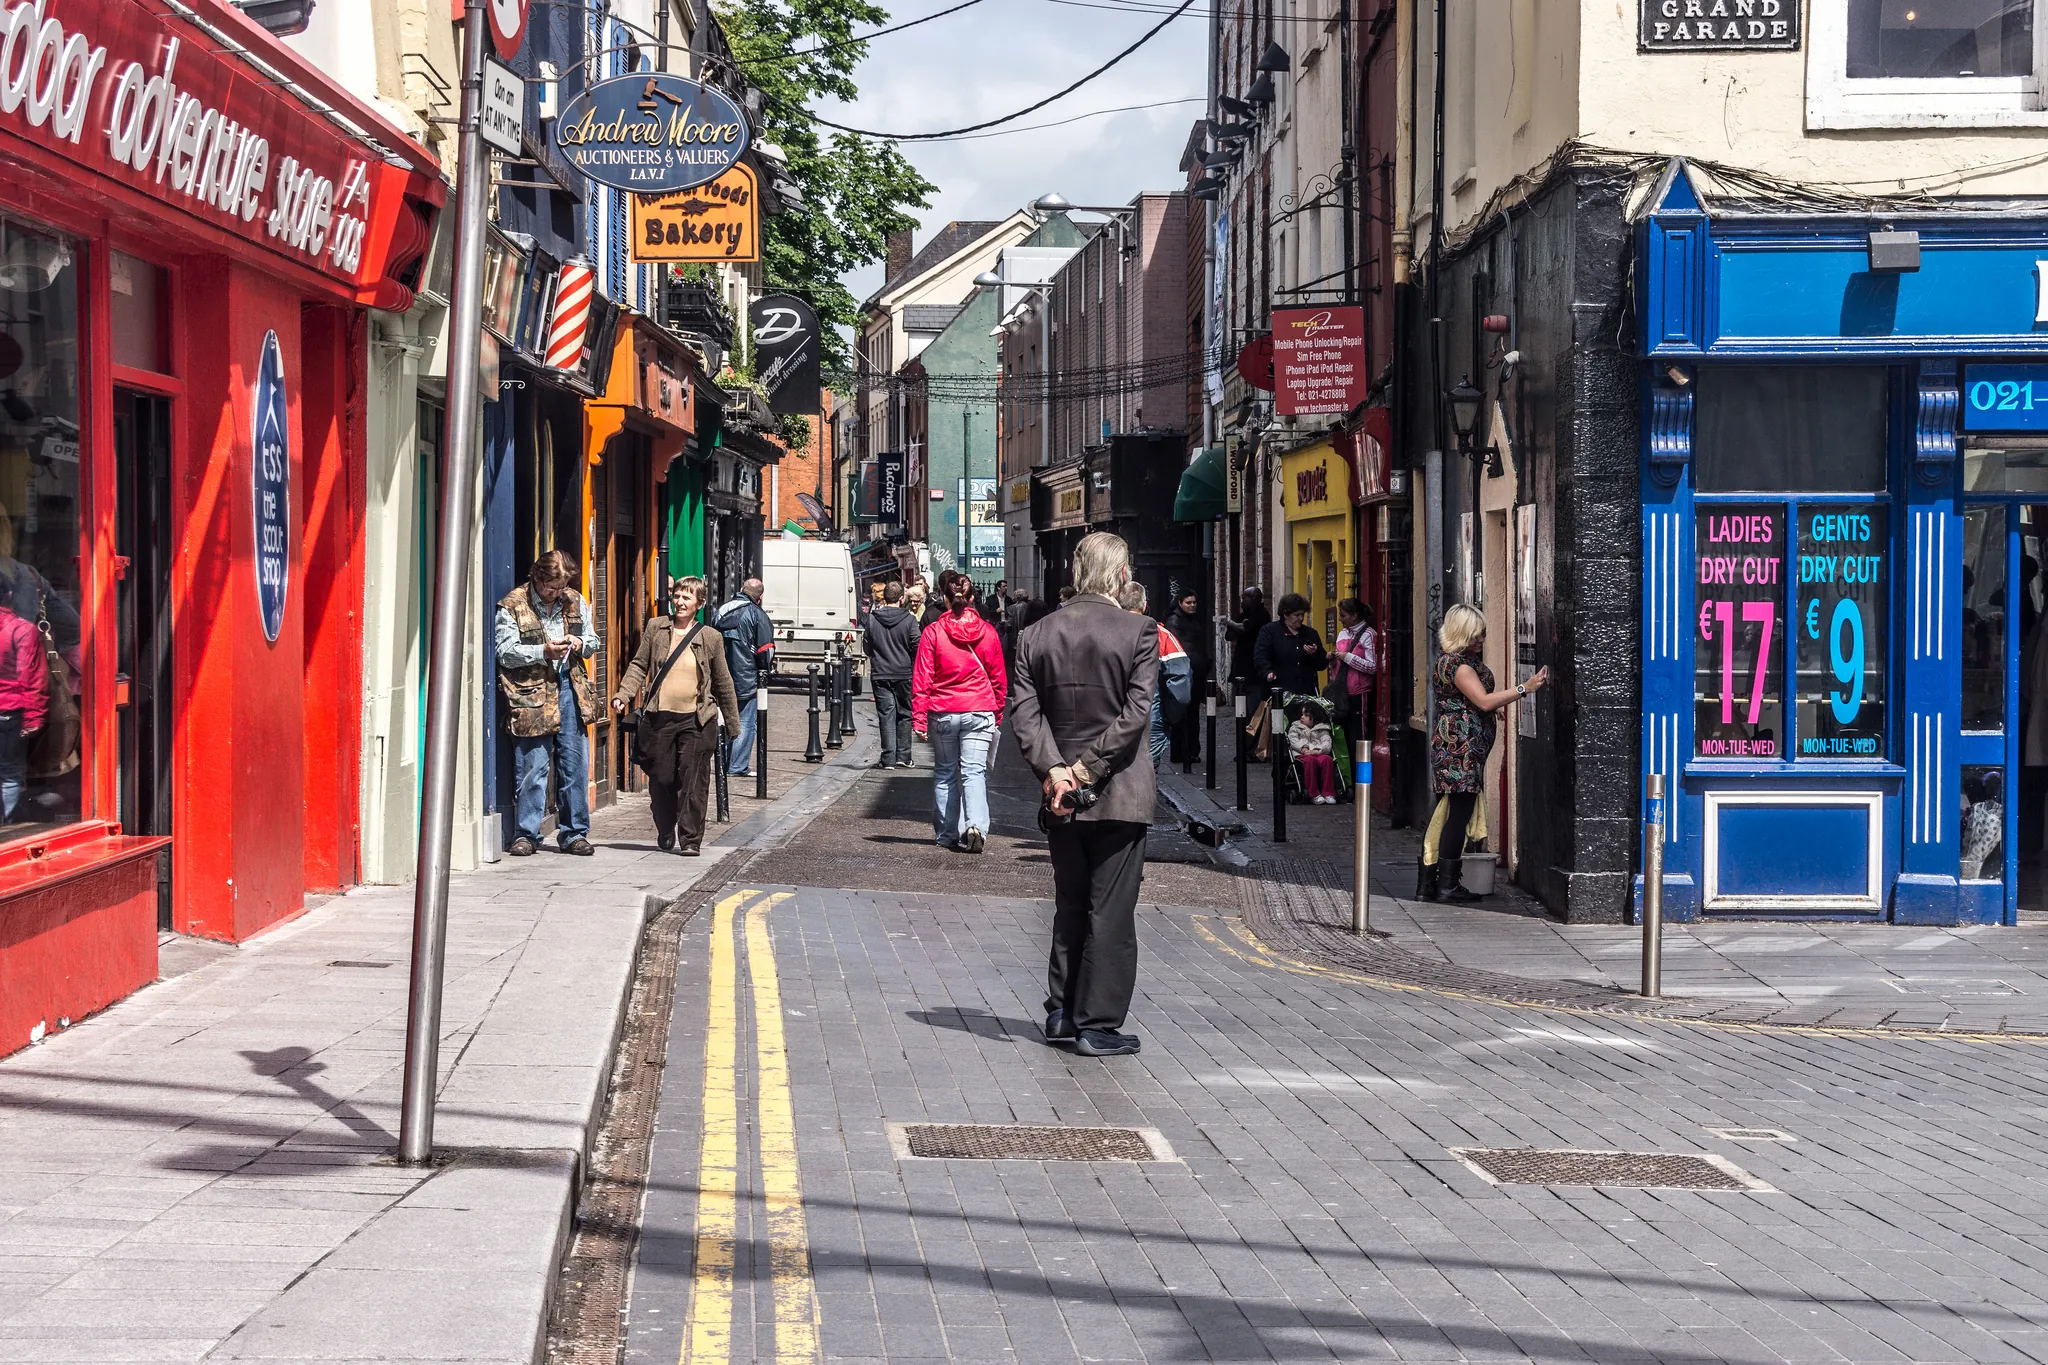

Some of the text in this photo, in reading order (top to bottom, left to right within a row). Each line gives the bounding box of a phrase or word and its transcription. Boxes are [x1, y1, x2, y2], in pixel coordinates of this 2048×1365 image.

[1661, 0, 1780, 18] GRAND
[1653, 20, 1788, 40] PARADE
[484, 104, 520, 143] AT ANY TIME
[557, 104, 740, 147] Andrew Moore
[109, 36, 269, 222] adventure
[268, 156, 333, 256] store
[574, 149, 730, 168] AUCTIONEERS & VALUERS
[645, 218, 743, 256] Bakery
[1274, 339, 1294, 350] Mobile
[1295, 338, 1313, 349] Phone
[1296, 350, 1342, 362] Sim Free Phone
[782, 352, 808, 380] dressing
[1285, 362, 1354, 376] iPhone iPad iPod Repair
[1286, 378, 1307, 390] Laptop
[1334, 375, 1354, 387] Repair
[1296, 390, 1307, 401] Tel:
[1294, 401, 1349, 415] www.techmaster.ie
[262, 441, 283, 484] tss
[1229, 449, 1238, 501] WOODFORD
[885, 462, 901, 514] Puccino's
[263, 490, 276, 520] the
[263, 523, 283, 554] scout
[1709, 515, 1773, 543] LADIES
[1811, 514, 1871, 542] GENTS
[263, 556, 281, 587] shop
[1701, 557, 1780, 585] DRY CUT
[1801, 556, 1881, 584] DRY CUT
[1702, 739, 1775, 756] MON-TUE-WED
[1803, 738, 1876, 754] MON-TUE-WED
